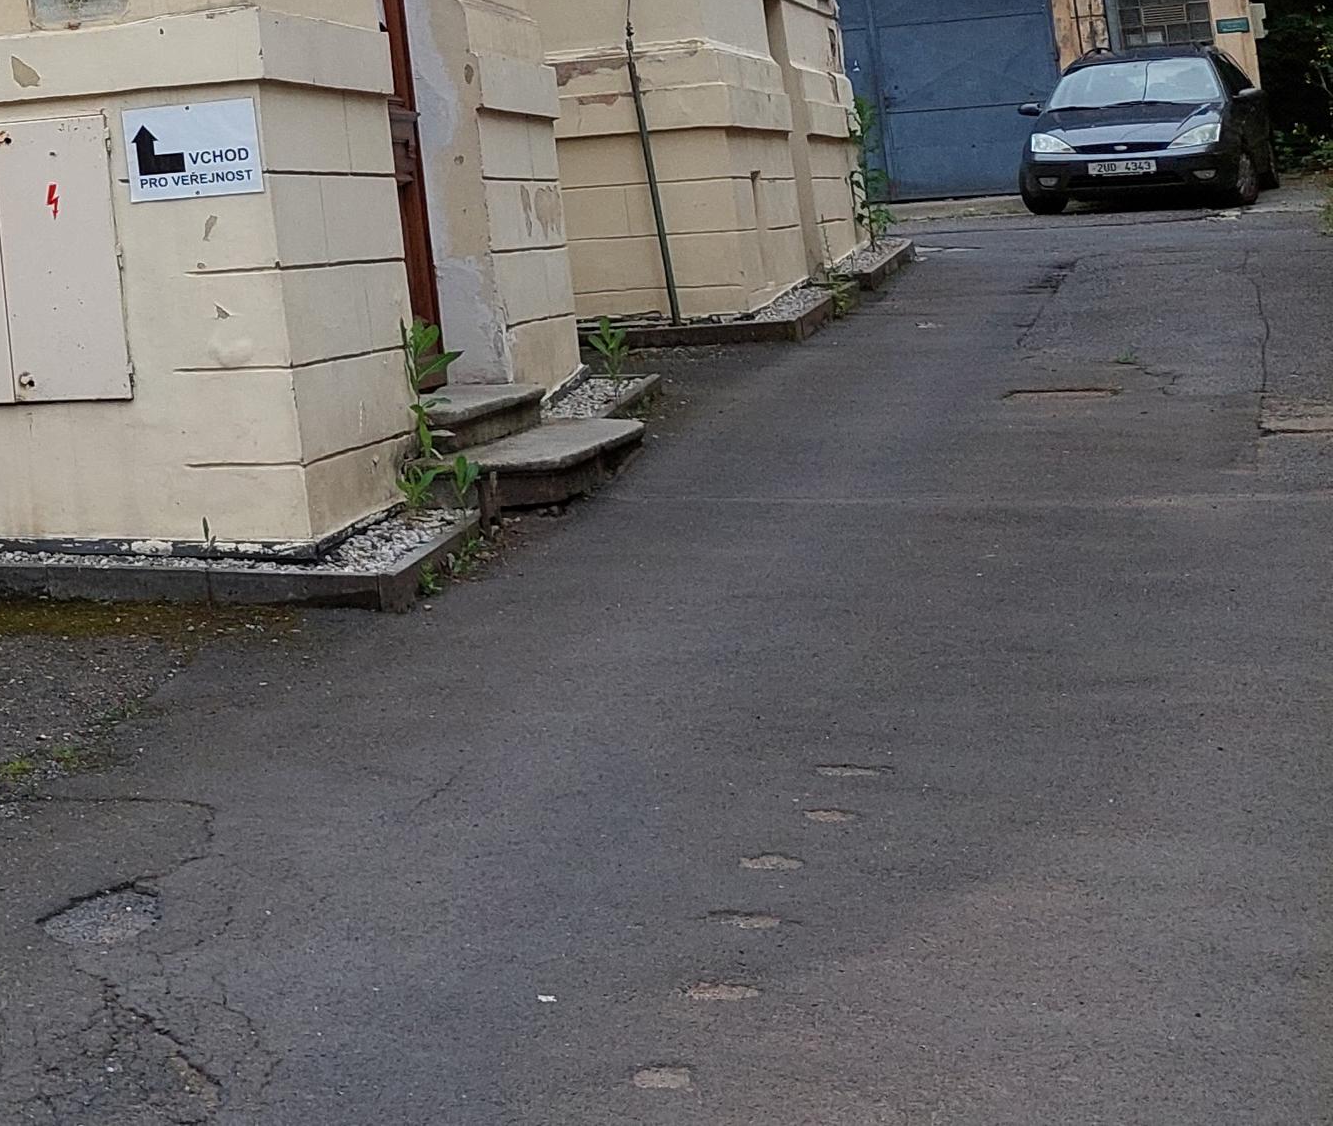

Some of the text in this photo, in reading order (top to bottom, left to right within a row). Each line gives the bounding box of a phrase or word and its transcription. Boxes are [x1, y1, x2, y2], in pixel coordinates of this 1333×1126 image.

[189, 148, 249, 164] VCHOD
[1125, 161, 1150, 171] 4343
[140, 169, 252, 188] PRO VEŘEJNOST
